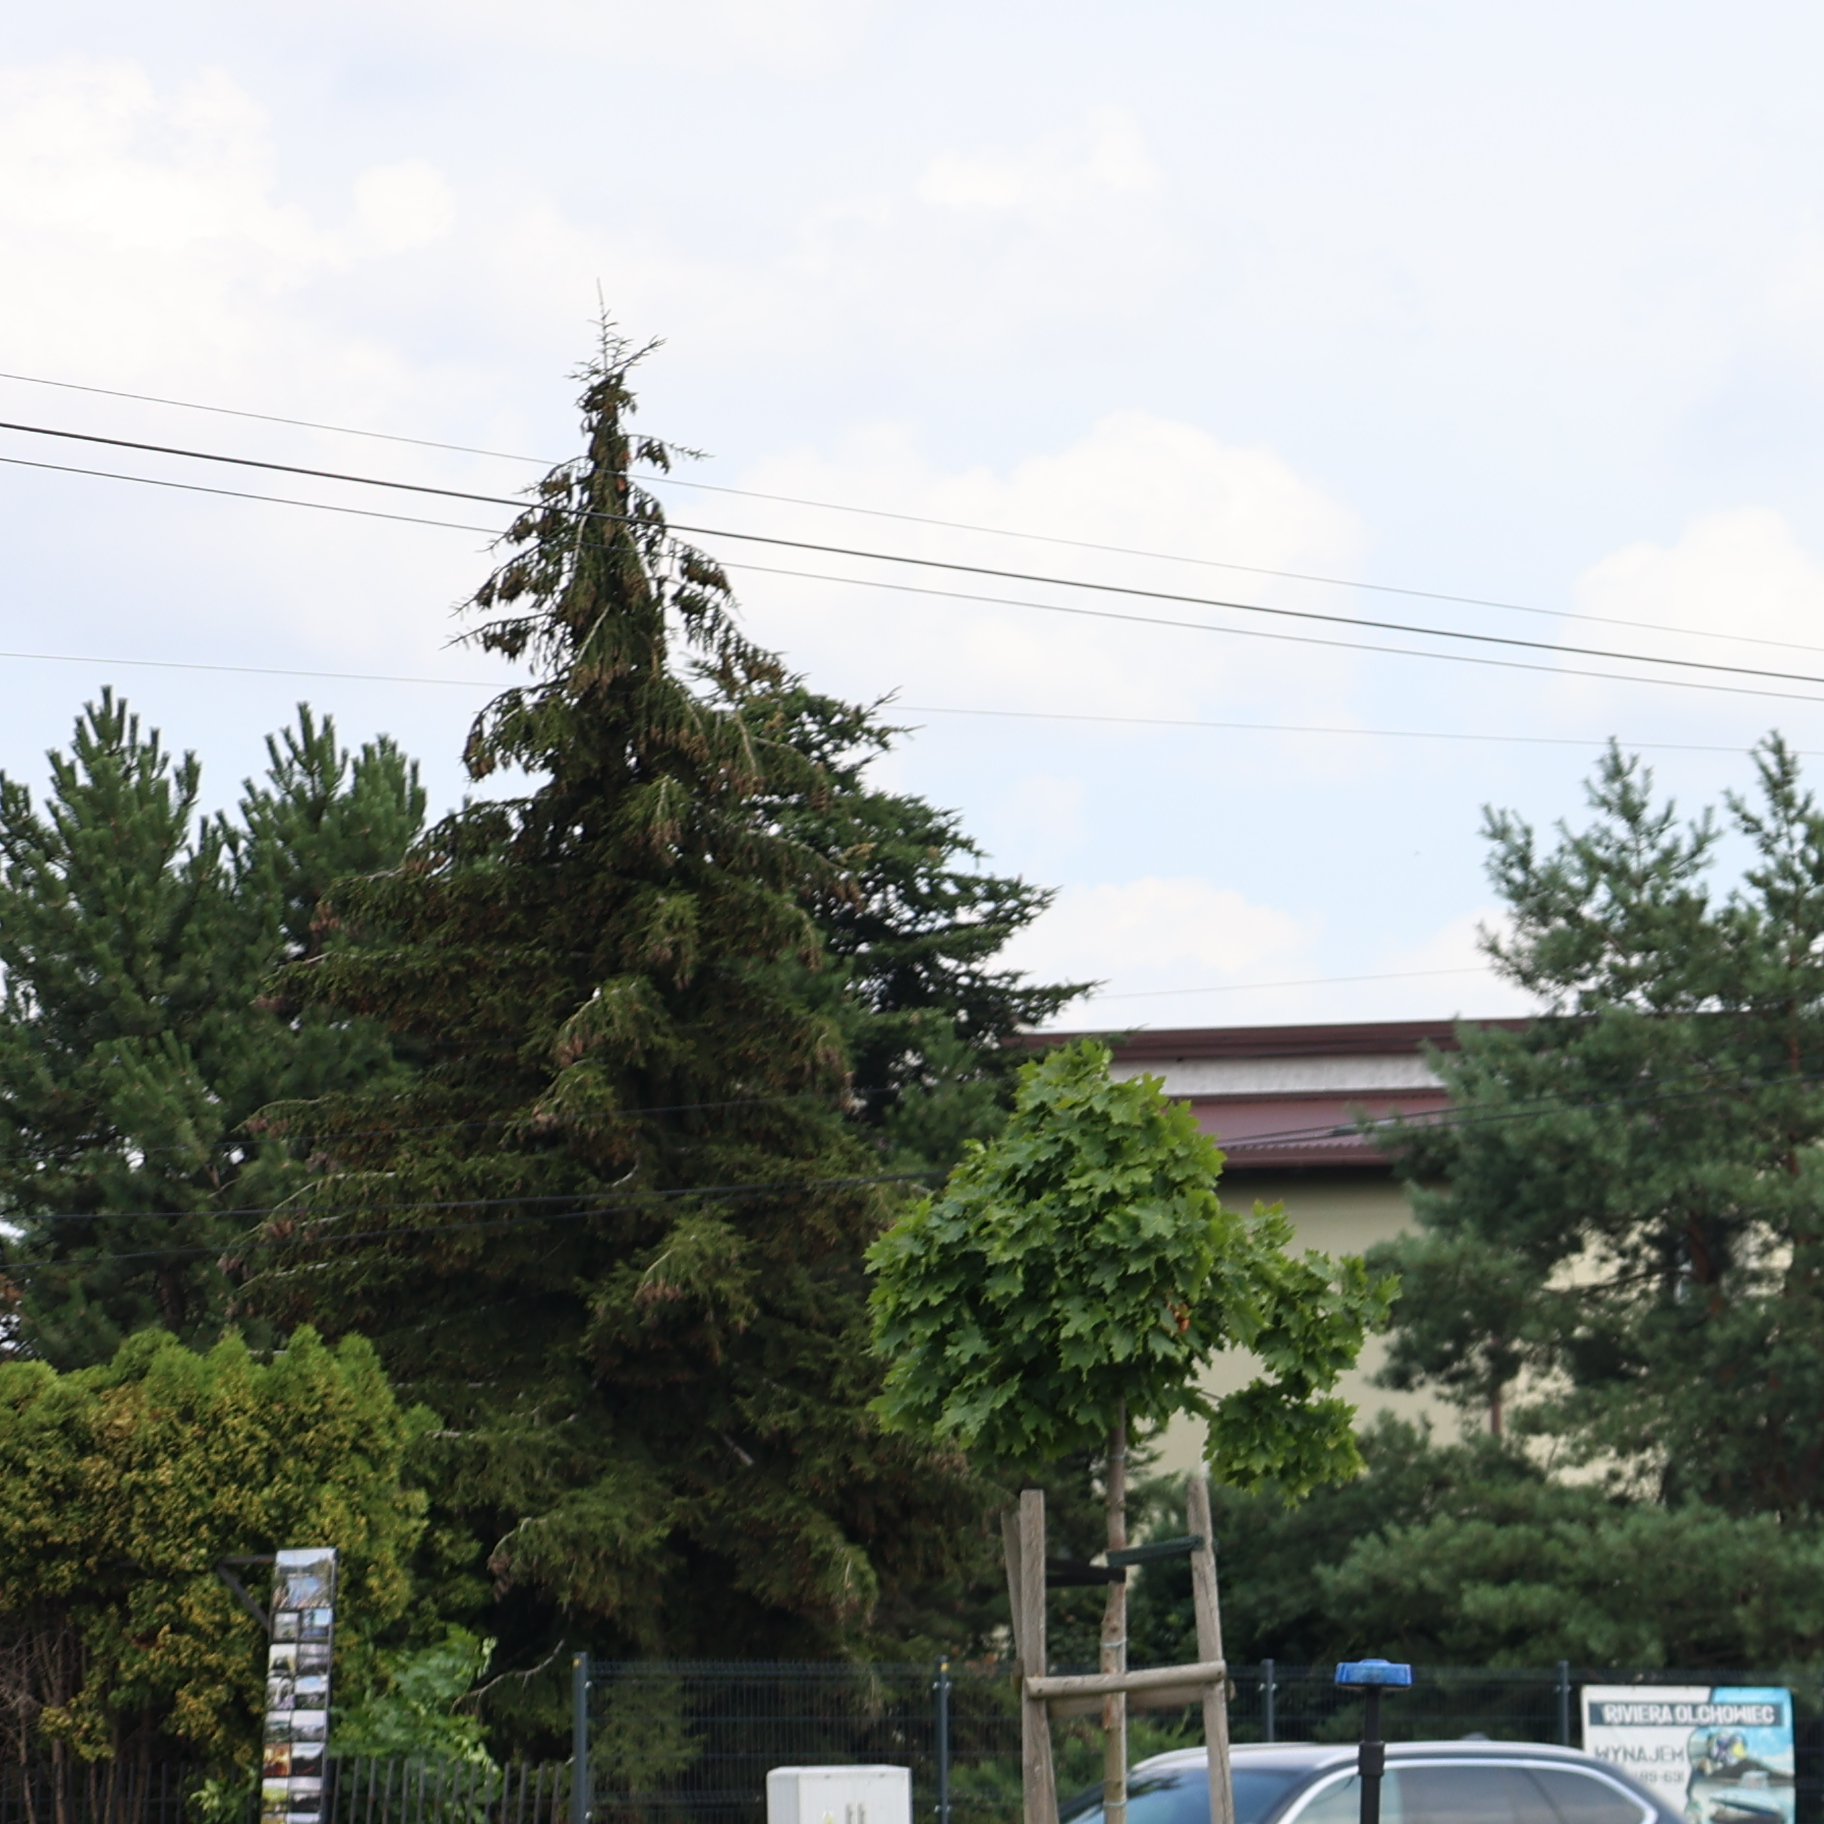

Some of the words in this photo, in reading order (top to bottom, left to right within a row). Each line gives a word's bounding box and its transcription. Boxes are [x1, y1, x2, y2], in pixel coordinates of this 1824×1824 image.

[1603, 1704, 1672, 1724] RIVIERA
[1674, 1704, 1775, 1725] OLCHOWIEC
[1595, 1745, 1685, 1762] WYNAJEM
